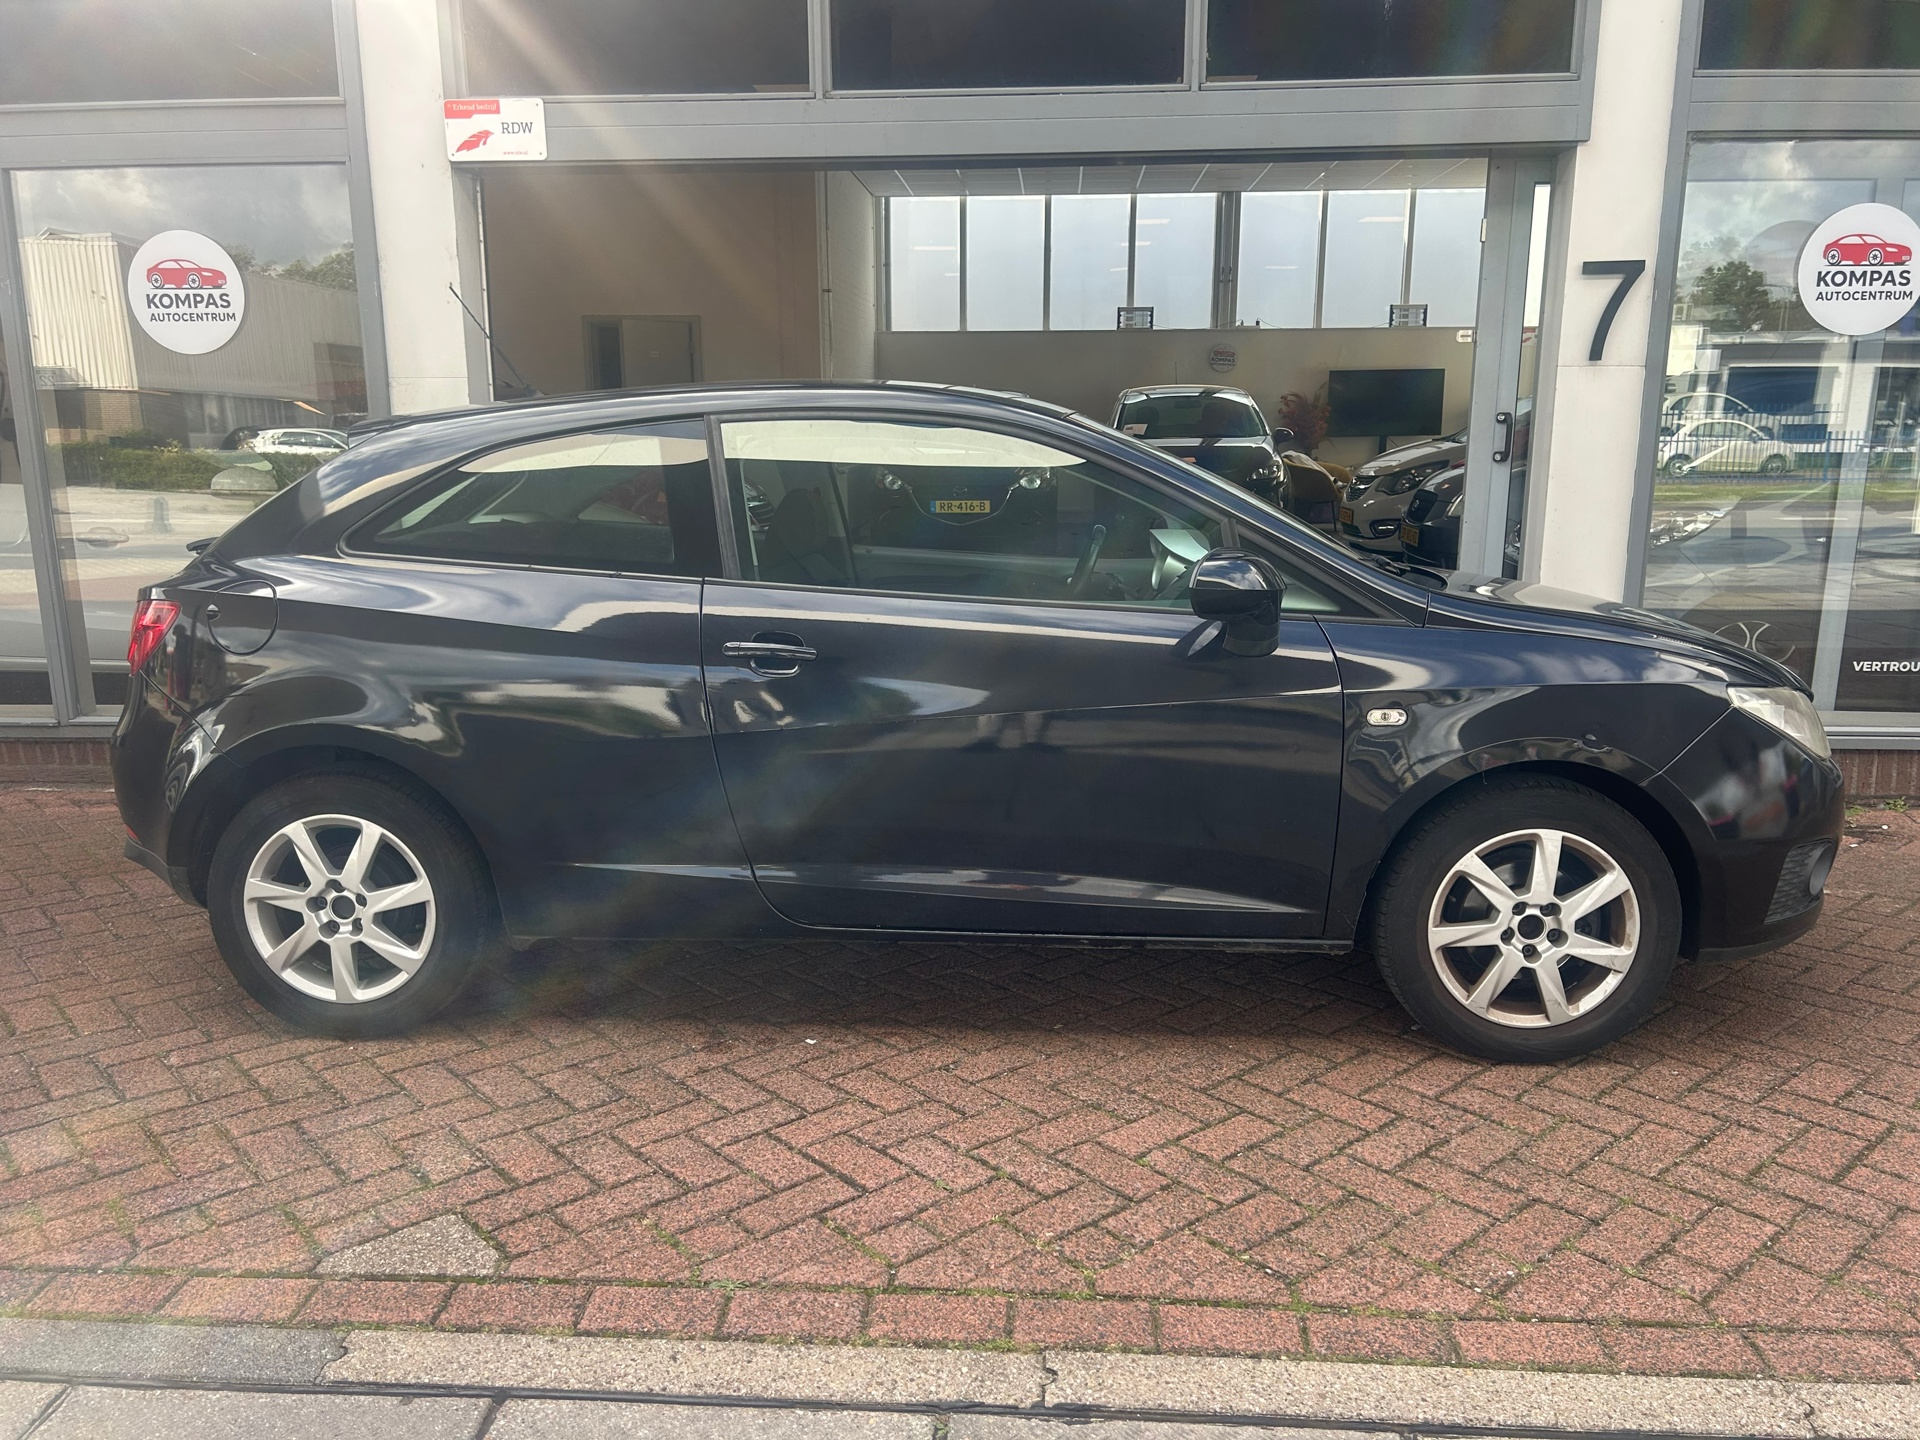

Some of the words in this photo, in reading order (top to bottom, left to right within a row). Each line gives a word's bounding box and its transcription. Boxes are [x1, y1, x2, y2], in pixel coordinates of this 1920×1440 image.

[452, 103, 475, 111] Erkend
[476, 103, 497, 112] bedrijf
[501, 121, 533, 134] RDW
[1816, 269, 1911, 287] KOMPAS
[146, 293, 231, 309] KOMPAS
[1815, 290, 1913, 301] AUTOCENTRUM
[1582, 259, 1646, 361] 7
[150, 312, 236, 322] AUTOCENTRUM
[940, 502, 986, 511] RR-416-B
